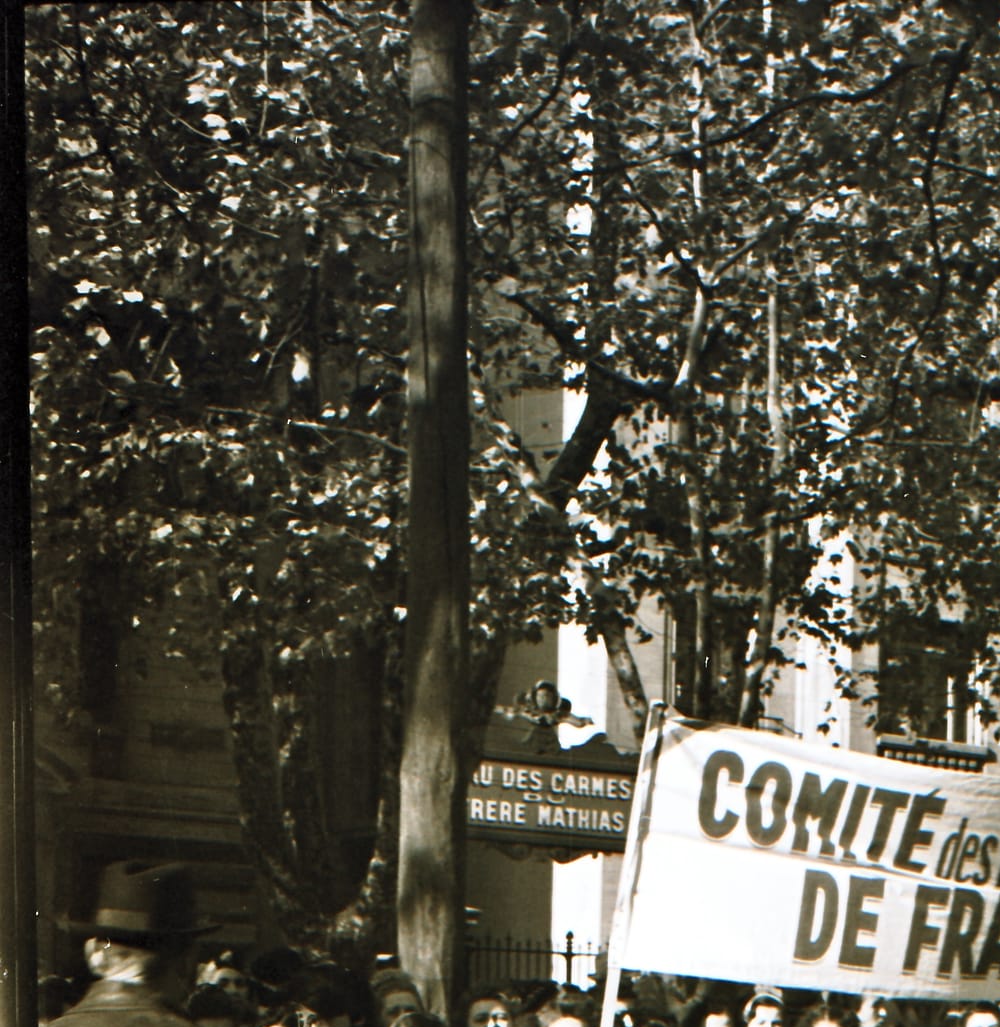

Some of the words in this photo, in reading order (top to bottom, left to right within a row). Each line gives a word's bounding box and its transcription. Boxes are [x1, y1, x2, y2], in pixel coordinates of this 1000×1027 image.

[468, 797, 528, 825] RERE
[537, 803, 625, 834] MATHIAS
[502, 767, 543, 792] DES
[551, 773, 632, 800] CARMES
[698, 749, 947, 873] COMITÉ
[934, 817, 999, 886] des
[793, 869, 886, 972] DE
